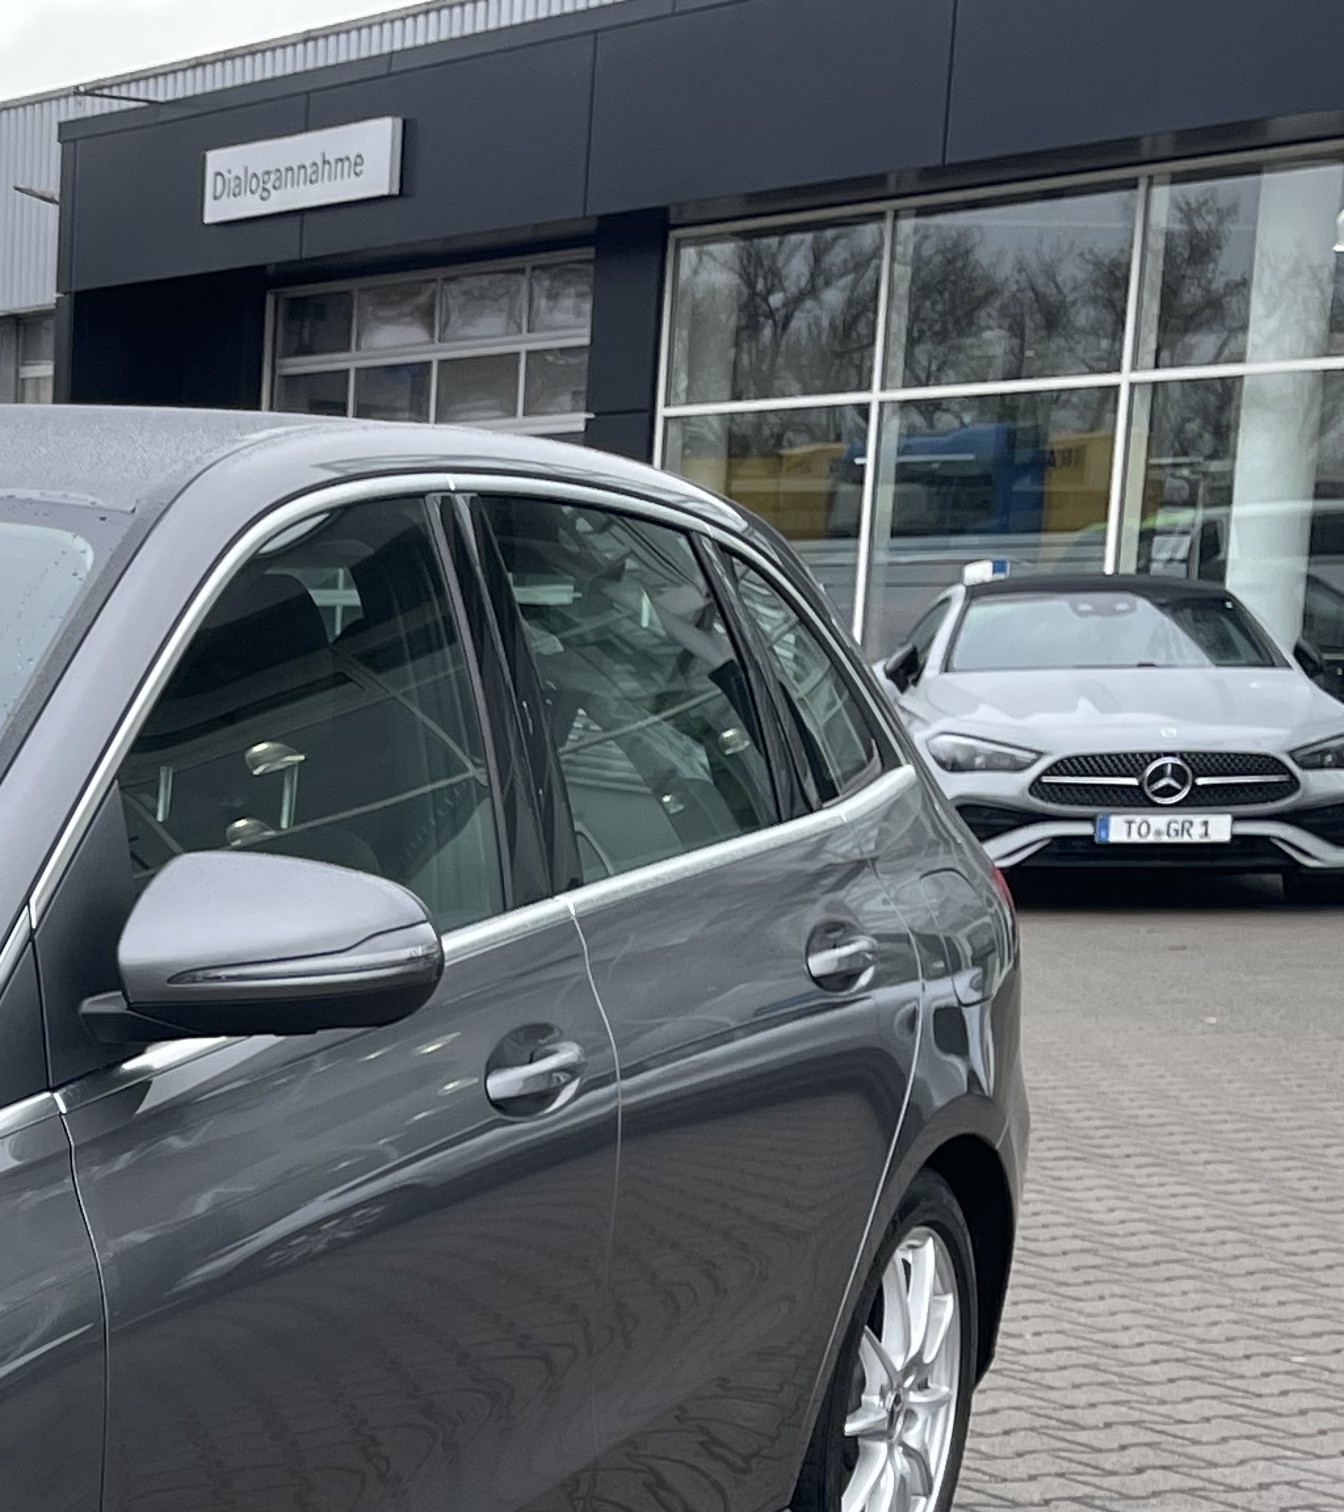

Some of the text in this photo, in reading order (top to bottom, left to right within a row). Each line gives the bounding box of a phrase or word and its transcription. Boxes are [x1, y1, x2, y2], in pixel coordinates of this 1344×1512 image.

[212, 152, 365, 202] Dialogannahme
[1123, 819, 1212, 839] TO GR 1
